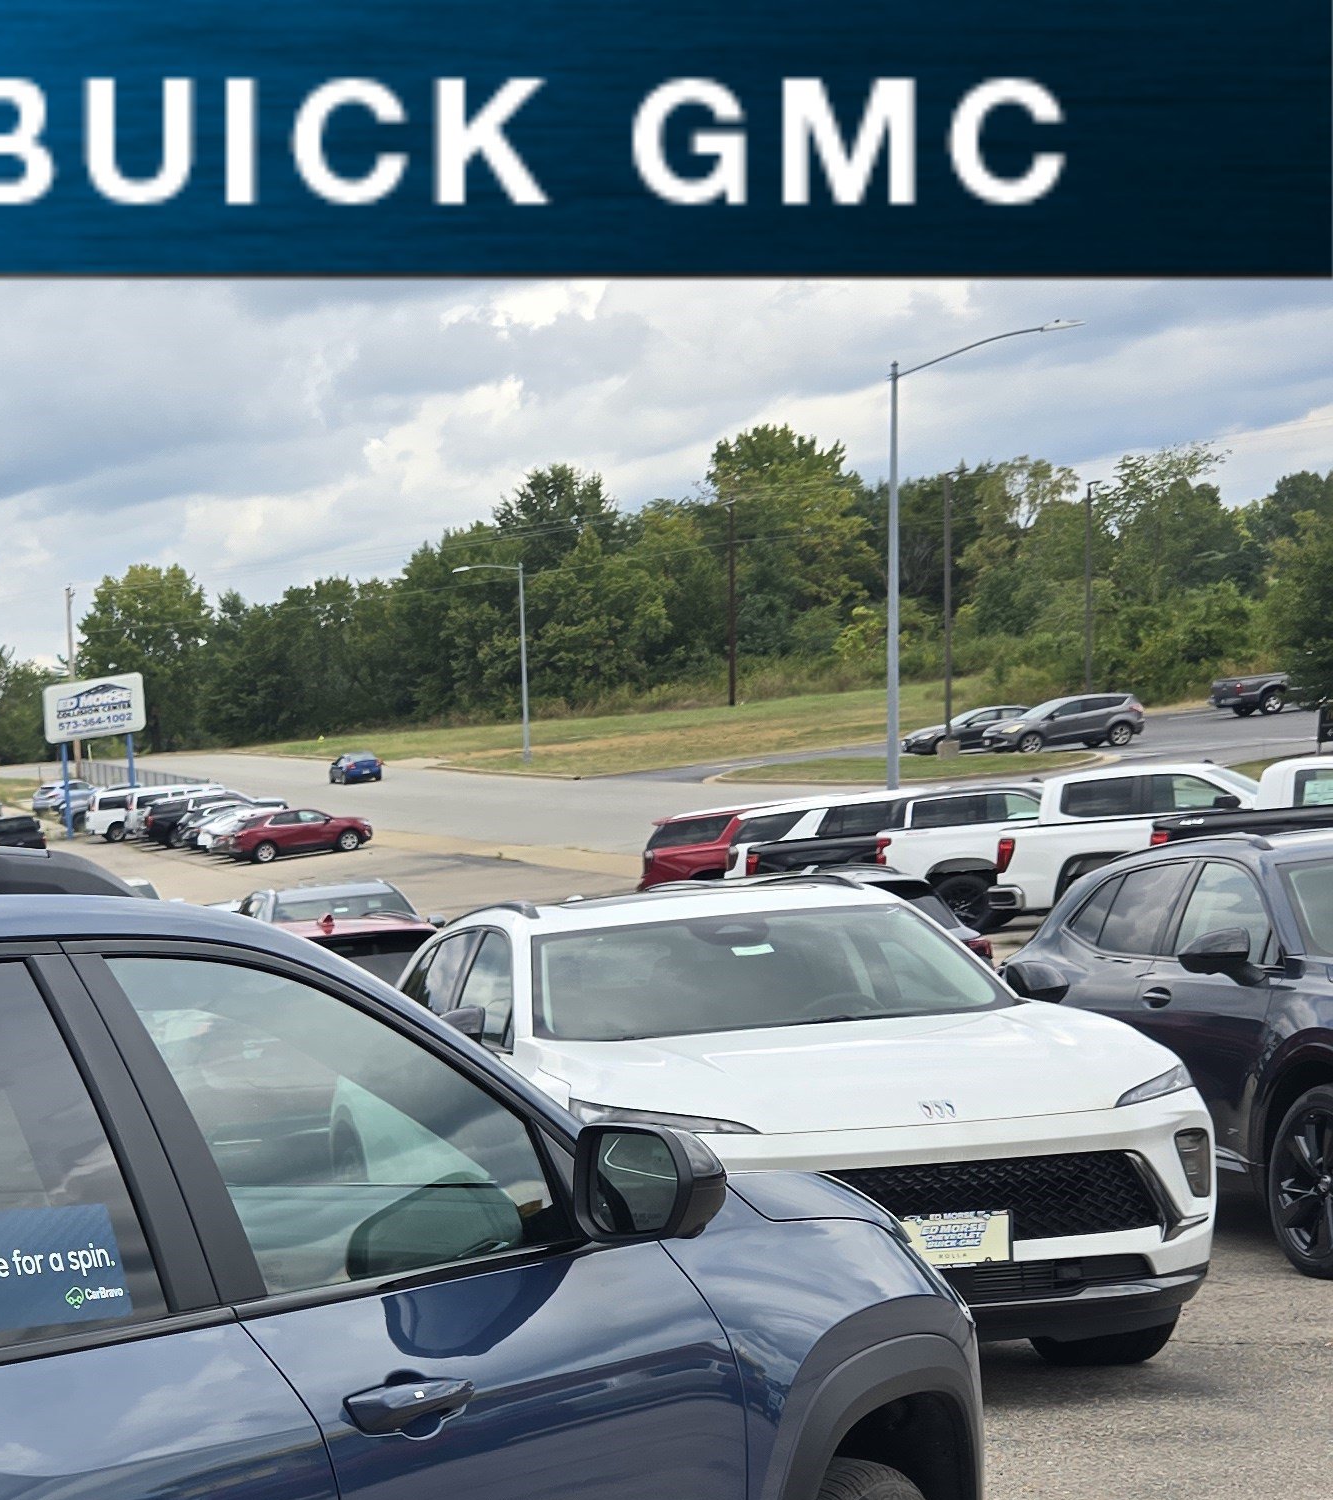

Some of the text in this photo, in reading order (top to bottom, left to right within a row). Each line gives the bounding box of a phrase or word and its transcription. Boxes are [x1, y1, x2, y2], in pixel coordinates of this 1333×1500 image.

[921, 1222, 986, 1236] ED MORSE
[12, 1249, 44, 1276] for
[48, 1251, 65, 1272] a
[67, 1243, 116, 1277] spin.
[84, 1285, 124, 1301] CarBravo
